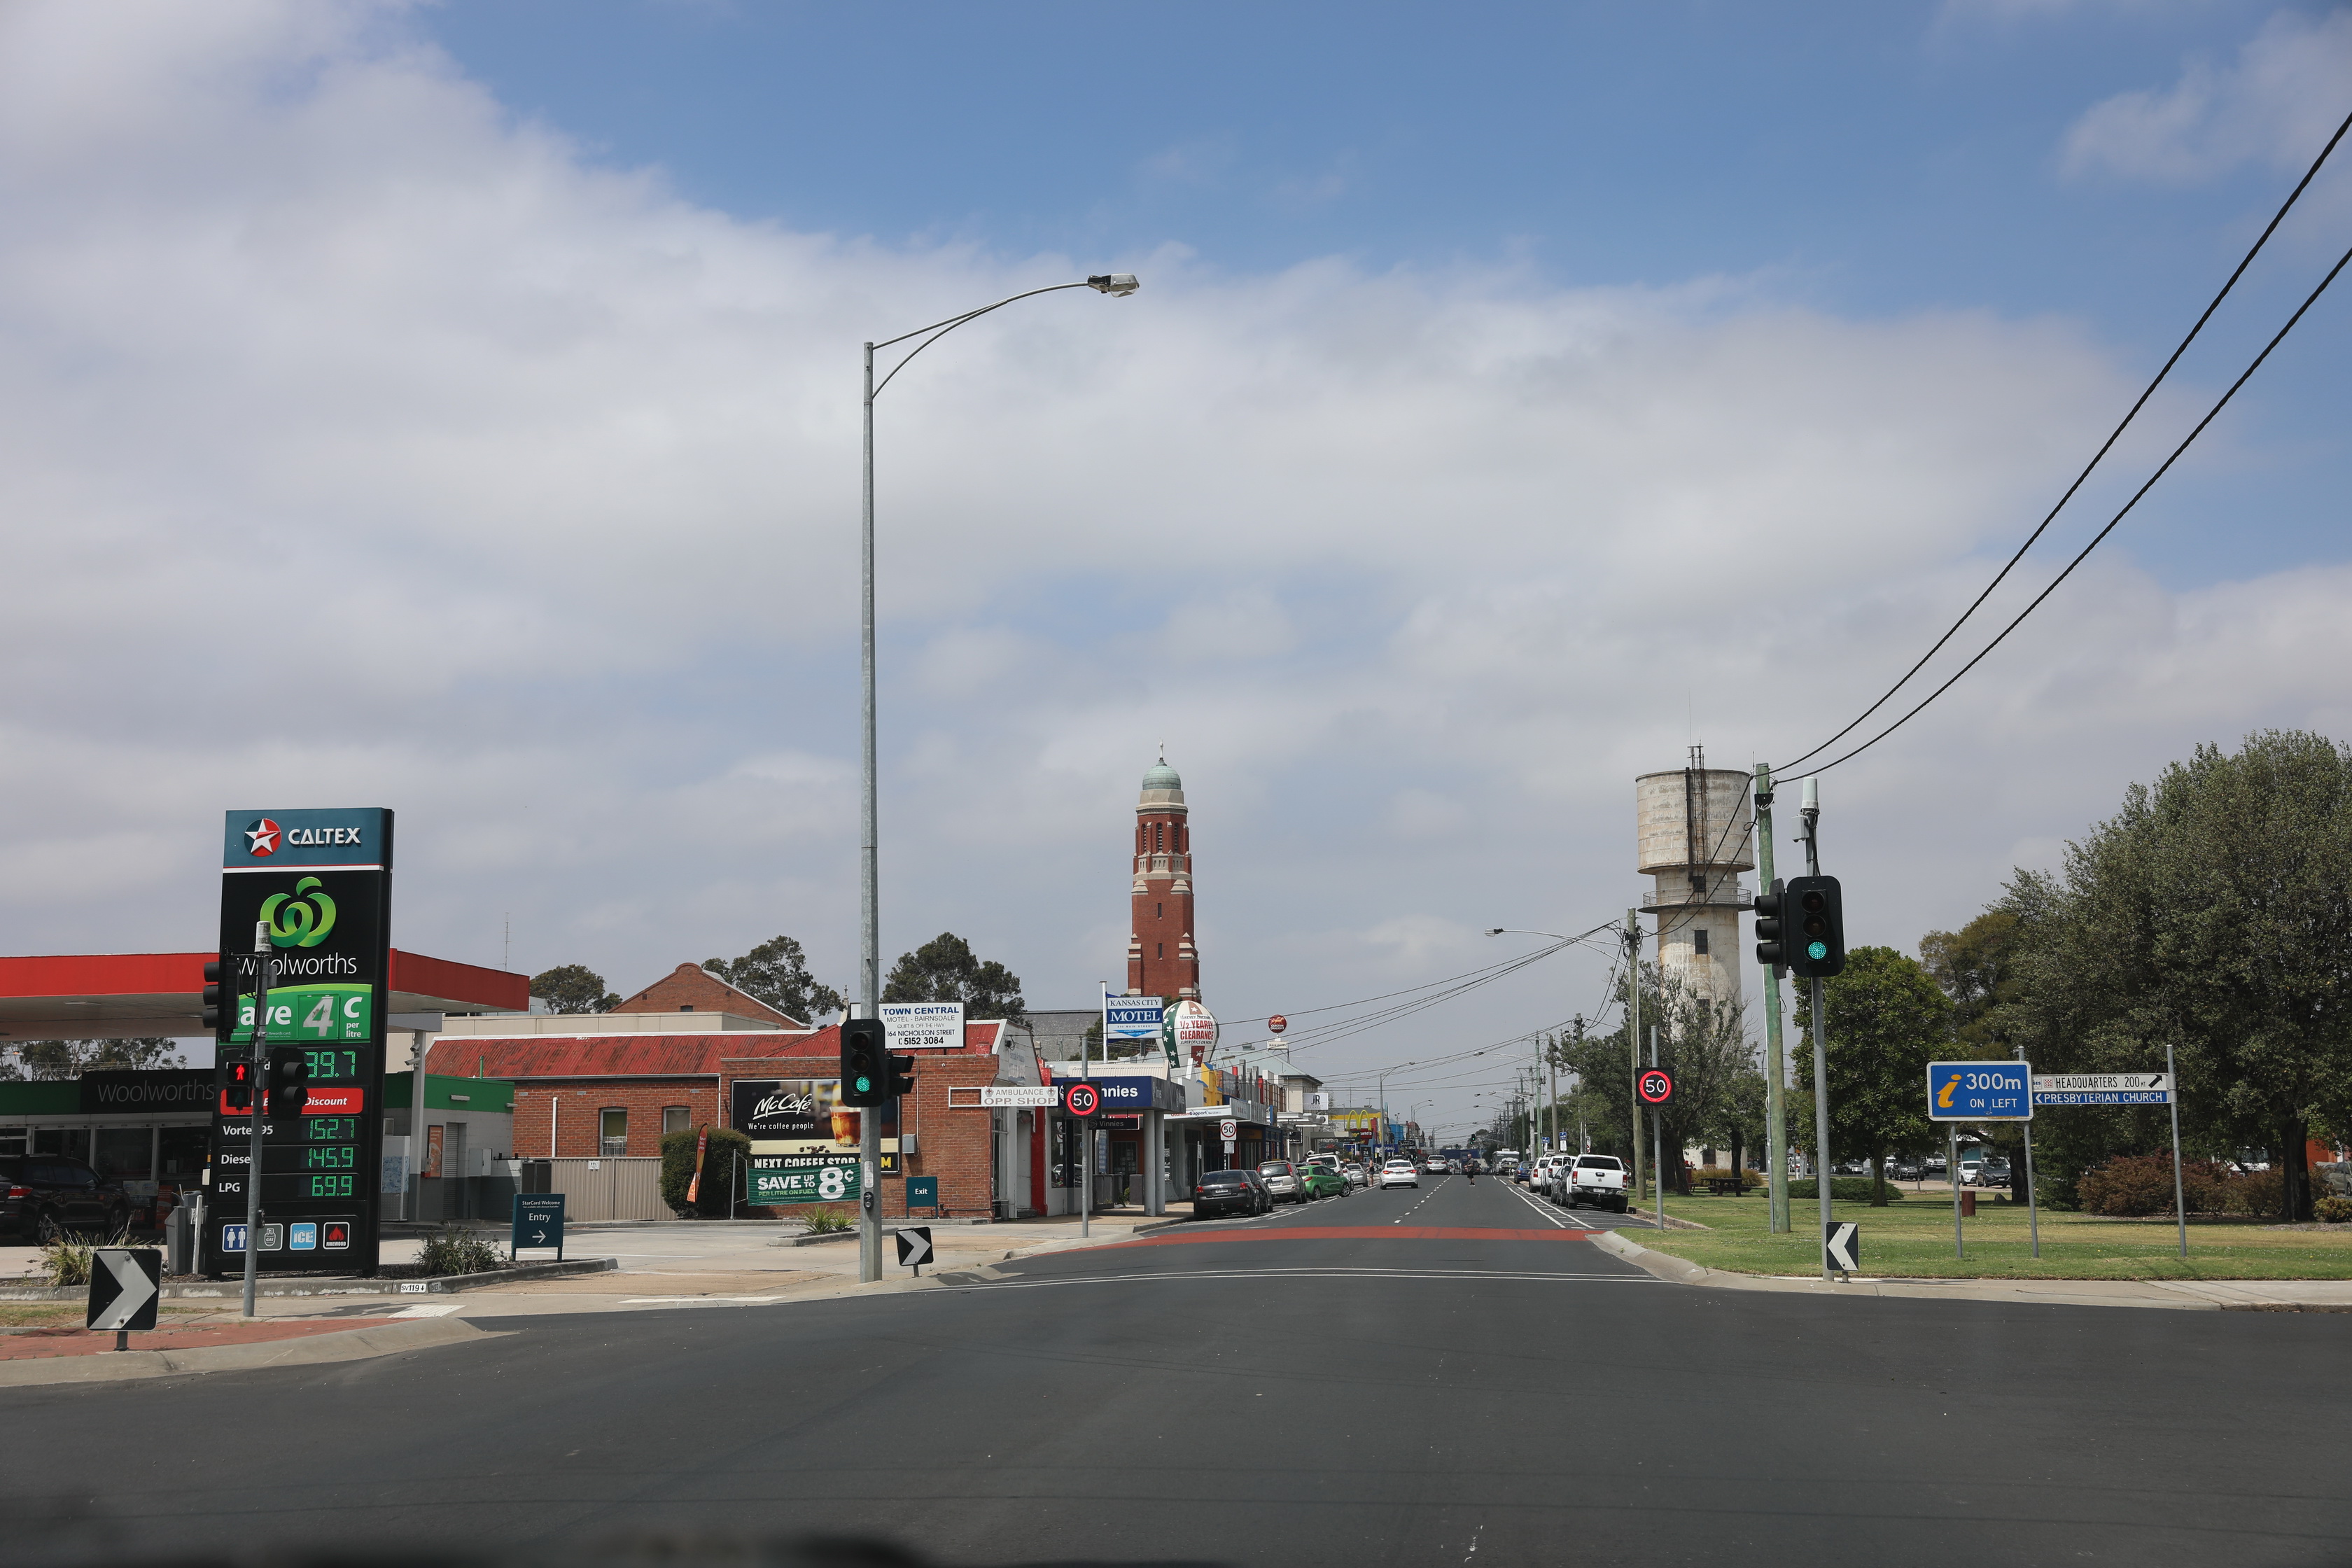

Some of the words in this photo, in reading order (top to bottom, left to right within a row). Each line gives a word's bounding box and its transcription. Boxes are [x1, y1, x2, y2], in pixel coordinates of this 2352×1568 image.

[288, 827, 361, 845] CALTEX
[237, 952, 357, 975] Wolworths
[239, 1004, 292, 1026] ave
[302, 996, 334, 1037] 4
[1110, 1010, 1161, 1022] MOTEL
[346, 1022, 360, 1030] per
[1191, 1020, 1213, 1030] YEARLY
[1180, 1030, 1214, 1040] CLEARANCE
[1646, 1079, 1666, 1093] 50
[1966, 1073, 2022, 1090] 300m
[2056, 1076, 2118, 1088] HEADQUARTERS
[98, 1079, 214, 1102] Woolworths
[305, 1097, 347, 1106] Discount
[1073, 1093, 1093, 1107] 50
[1311, 1095, 1320, 1105] JR
[1970, 1098, 1985, 1109] ON
[1992, 1098, 2017, 1109] LEFT
[2044, 1093, 2118, 1104] PRESBYTERIAN
[2122, 1092, 2163, 1103] CHURCH
[223, 1126, 252, 1135] Vorte
[309, 1119, 354, 1140] 152.7
[792, 1122, 814, 1130] people
[221, 1154, 251, 1164] Diese
[308, 1147, 354, 1168] 145.9
[755, 1158, 782, 1168] NEXT
[785, 1158, 825, 1168] COFFEE
[218, 1182, 240, 1193] LPG
[312, 1176, 352, 1196] 69.9
[757, 1176, 801, 1191] SAVE
[528, 1213, 551, 1223] Entry
